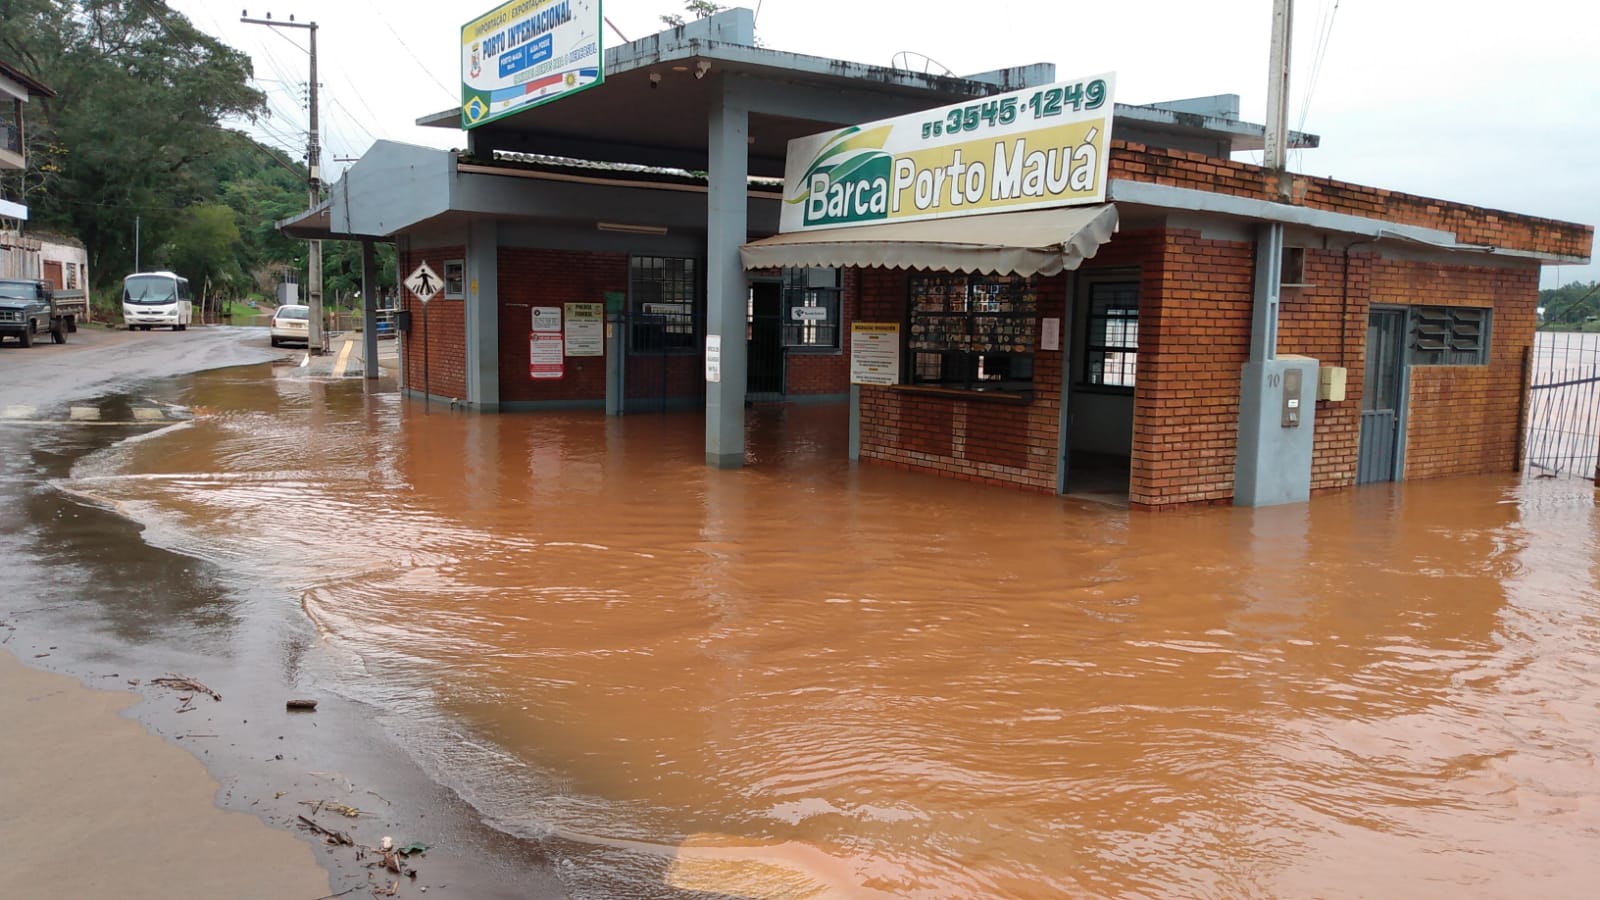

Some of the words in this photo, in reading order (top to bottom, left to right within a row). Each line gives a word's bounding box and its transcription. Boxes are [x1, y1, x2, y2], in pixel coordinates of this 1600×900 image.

[482, 31, 505, 60] PORTO
[508, 1, 571, 49] INTERNACIONAL
[921, 120, 942, 139] 55
[807, 172, 887, 221] Barca
[892, 149, 986, 212] Porto
[991, 127, 1099, 201] Mauá
